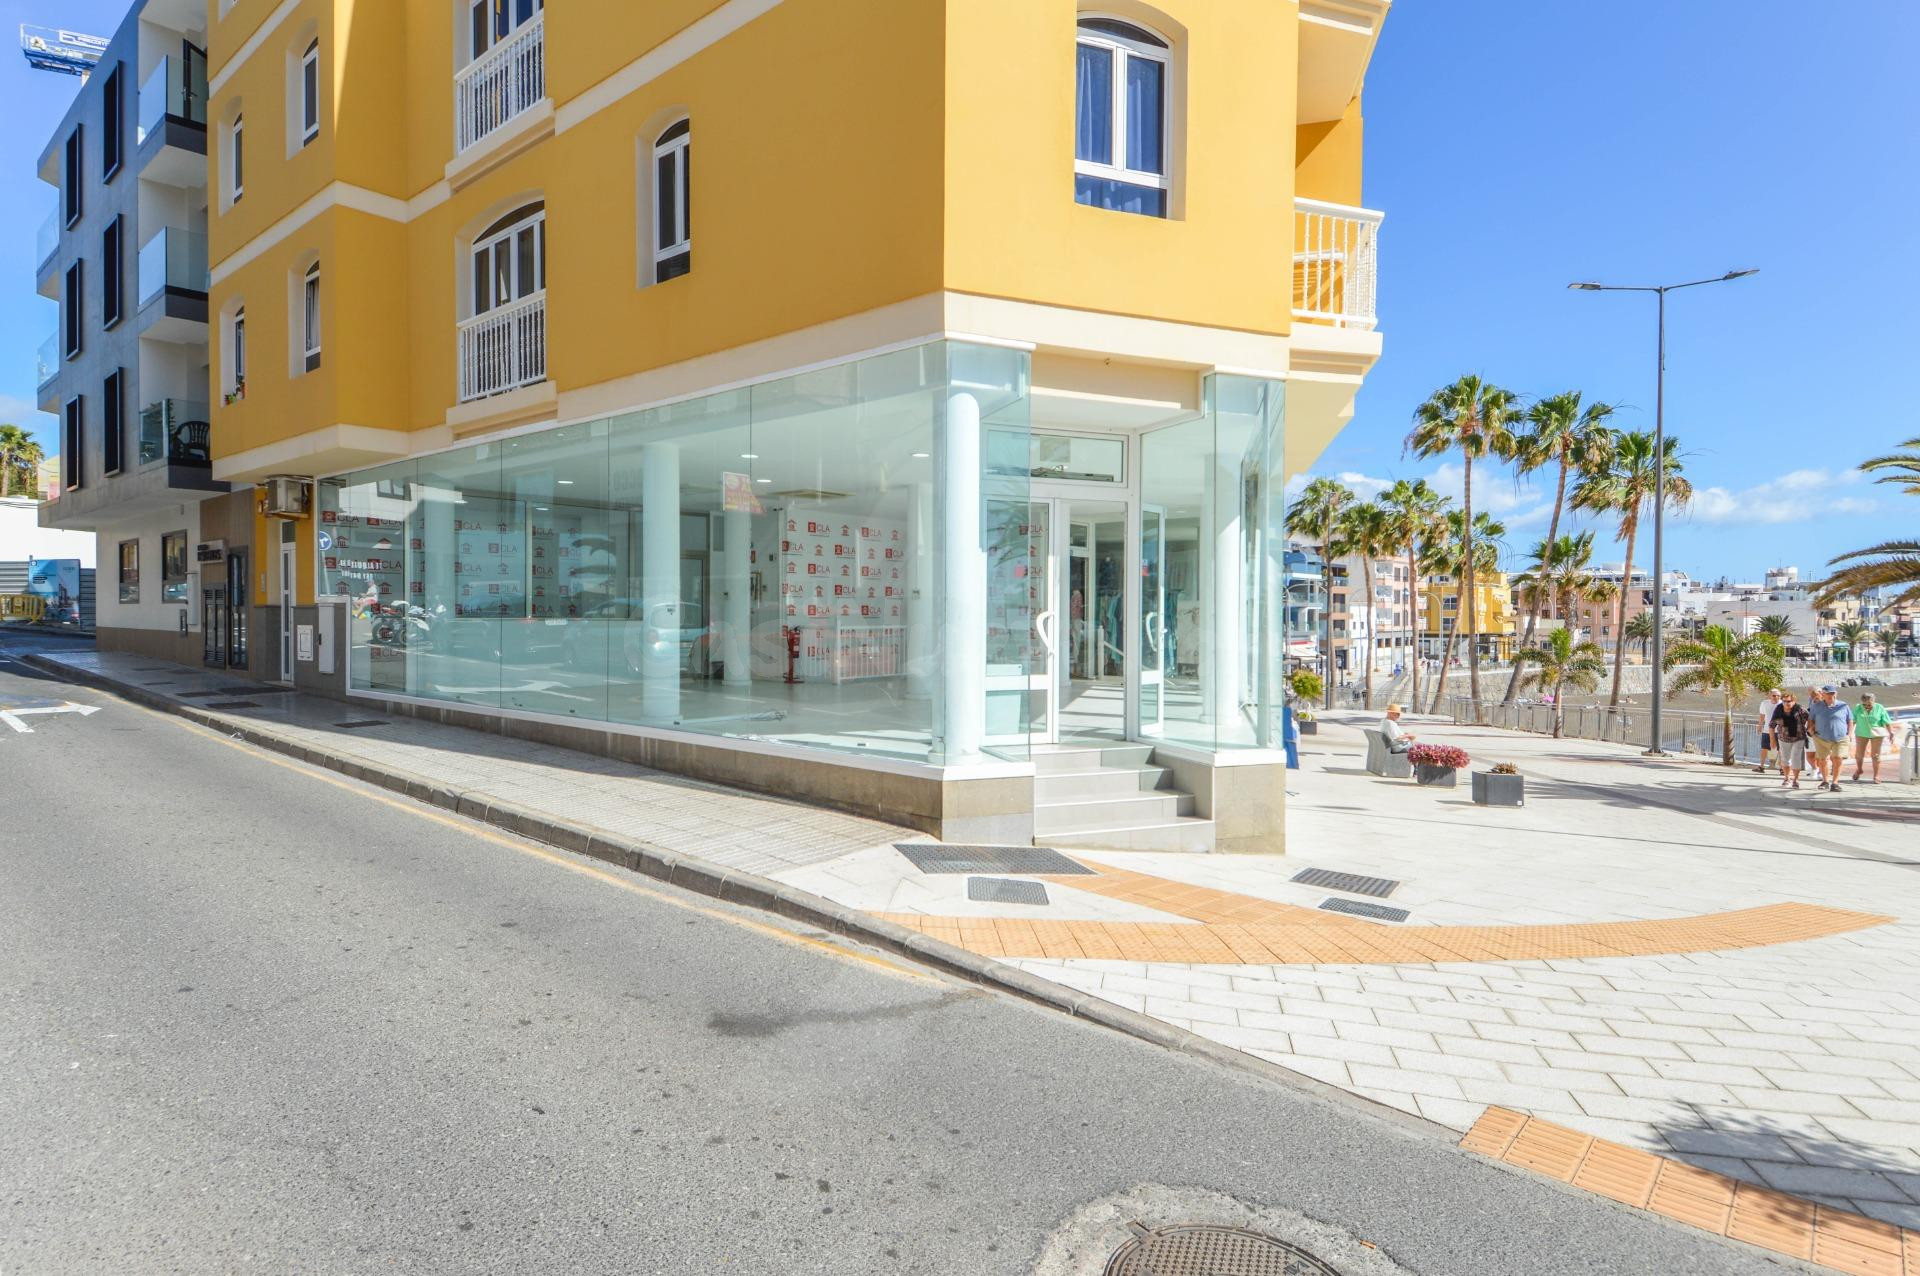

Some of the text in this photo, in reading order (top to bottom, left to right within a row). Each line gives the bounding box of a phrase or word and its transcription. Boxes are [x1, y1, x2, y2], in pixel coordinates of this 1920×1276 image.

[463, 521, 482, 531] CLA
[816, 523, 830, 533] CLA
[1030, 525, 1043, 533] CLA
[536, 527, 553, 536] CLA
[869, 529, 882, 537] CLA
[500, 544, 518, 553] CLA
[788, 542, 804, 551] CLA
[842, 547, 856, 555] CLA
[381, 560, 403, 569] CLA
[463, 564, 482, 572] CLA
[536, 567, 554, 577] CLA
[816, 564, 831, 574] CLA
[869, 568, 882, 576] CLA
[1030, 567, 1043, 575] CLA
[788, 585, 804, 593] CLA
[842, 586, 856, 594] CLA
[536, 605, 554, 614] CLA
[816, 606, 830, 614] CLA
[869, 606, 882, 614] CLA
